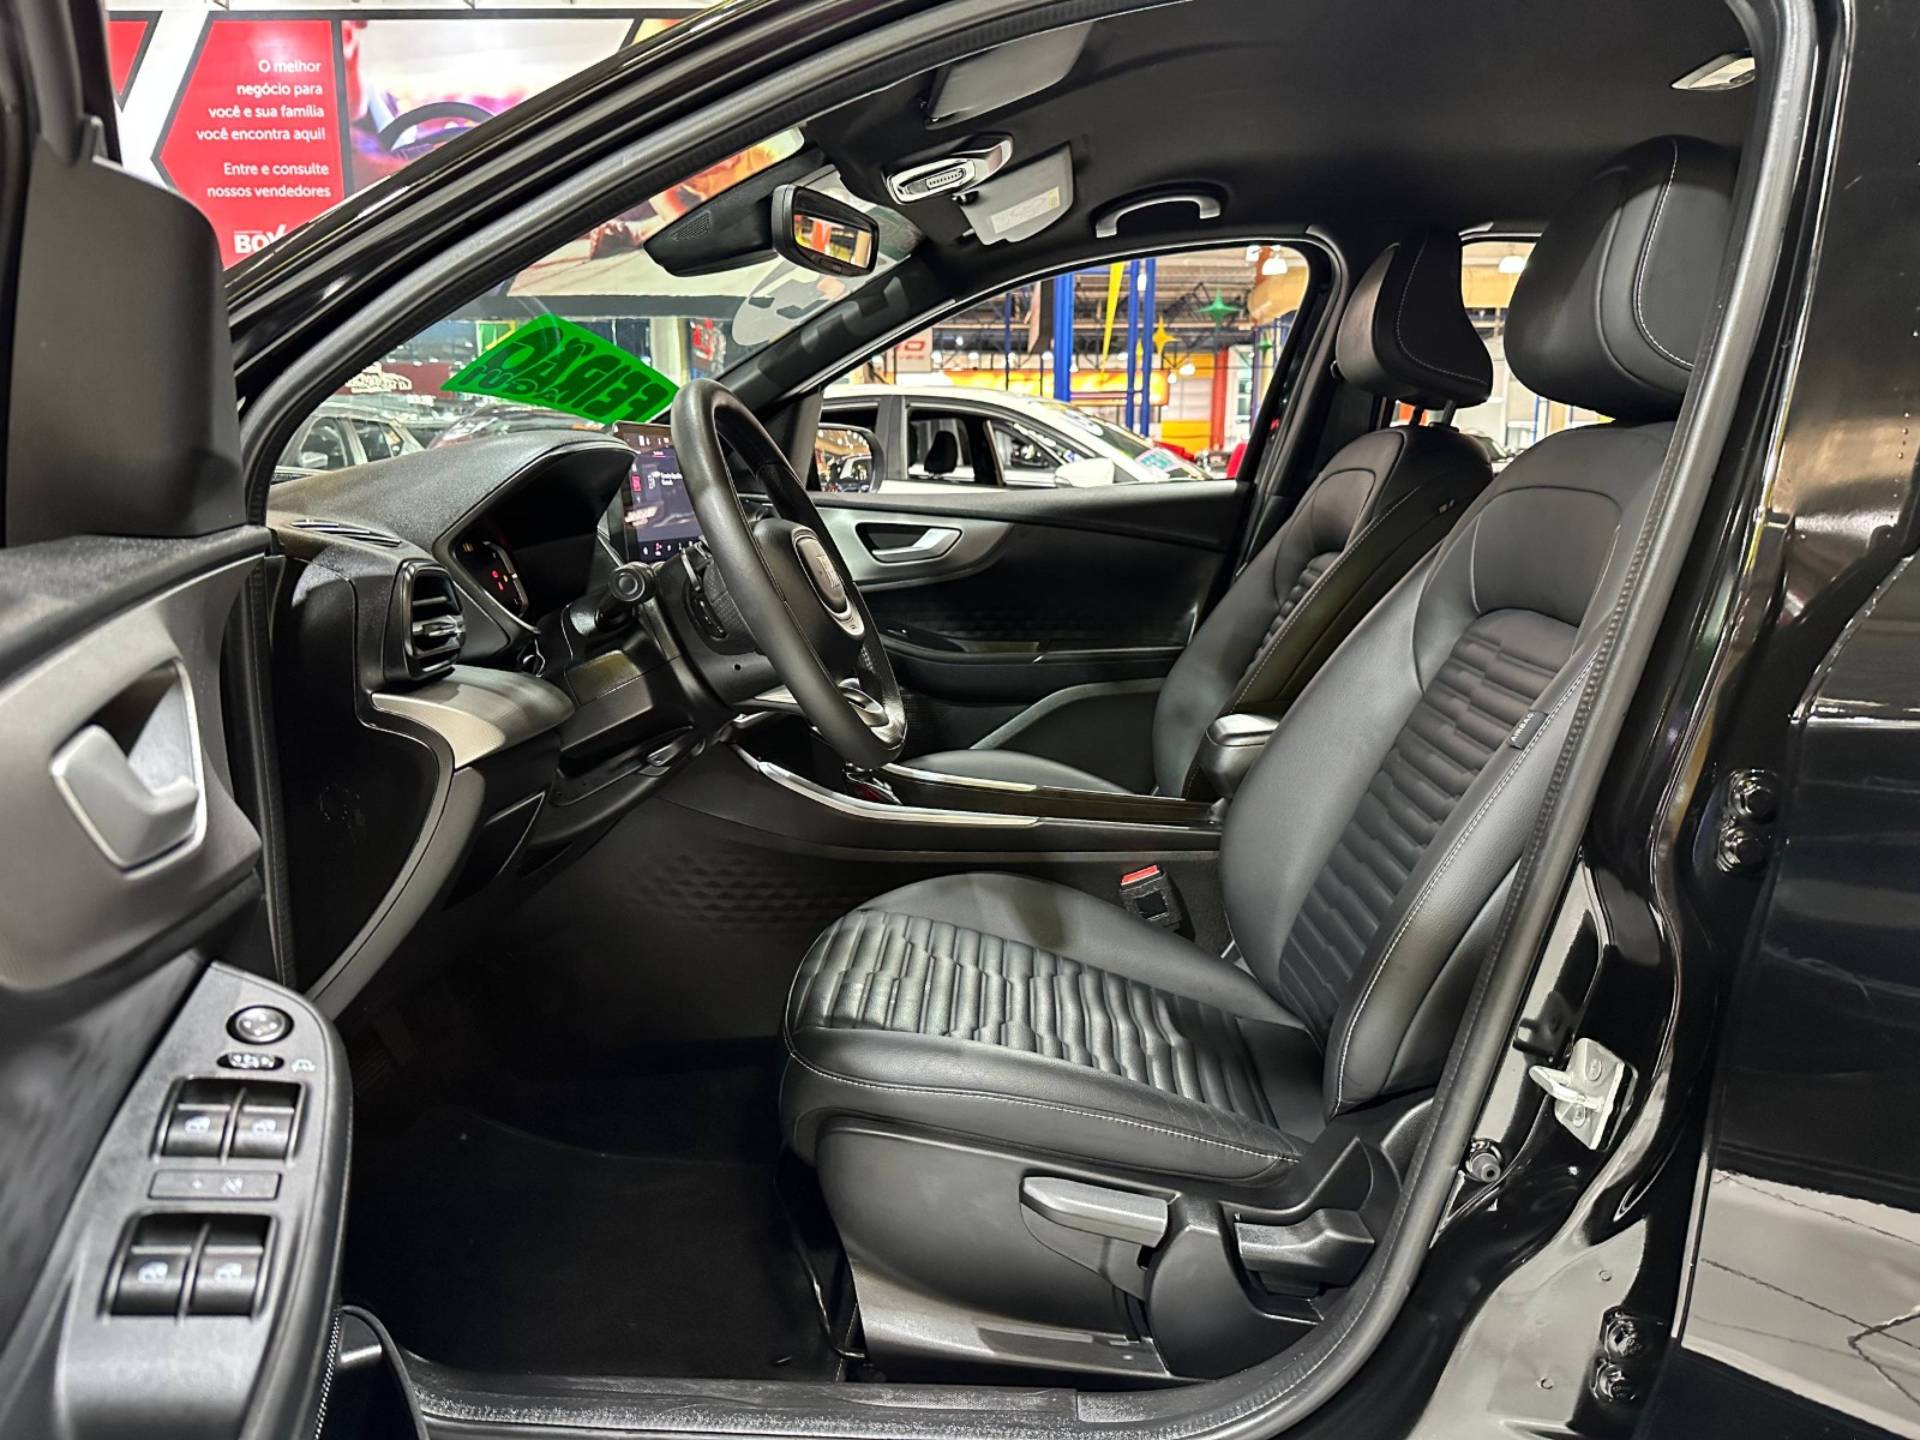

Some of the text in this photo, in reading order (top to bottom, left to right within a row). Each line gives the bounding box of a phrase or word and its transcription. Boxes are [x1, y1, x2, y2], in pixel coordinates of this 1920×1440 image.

[258, 59, 321, 73] O melhor
[236, 83, 323, 98] negócio para
[208, 105, 240, 118] você
[243, 107, 252, 118] e
[255, 107, 278, 118] sua
[196, 127, 228, 140] você
[231, 129, 290, 140] encontra
[223, 162, 329, 175] Entre e consulte
[207, 184, 331, 197] nossos vendedores
[1511, 712, 1534, 742] AIRBAG
